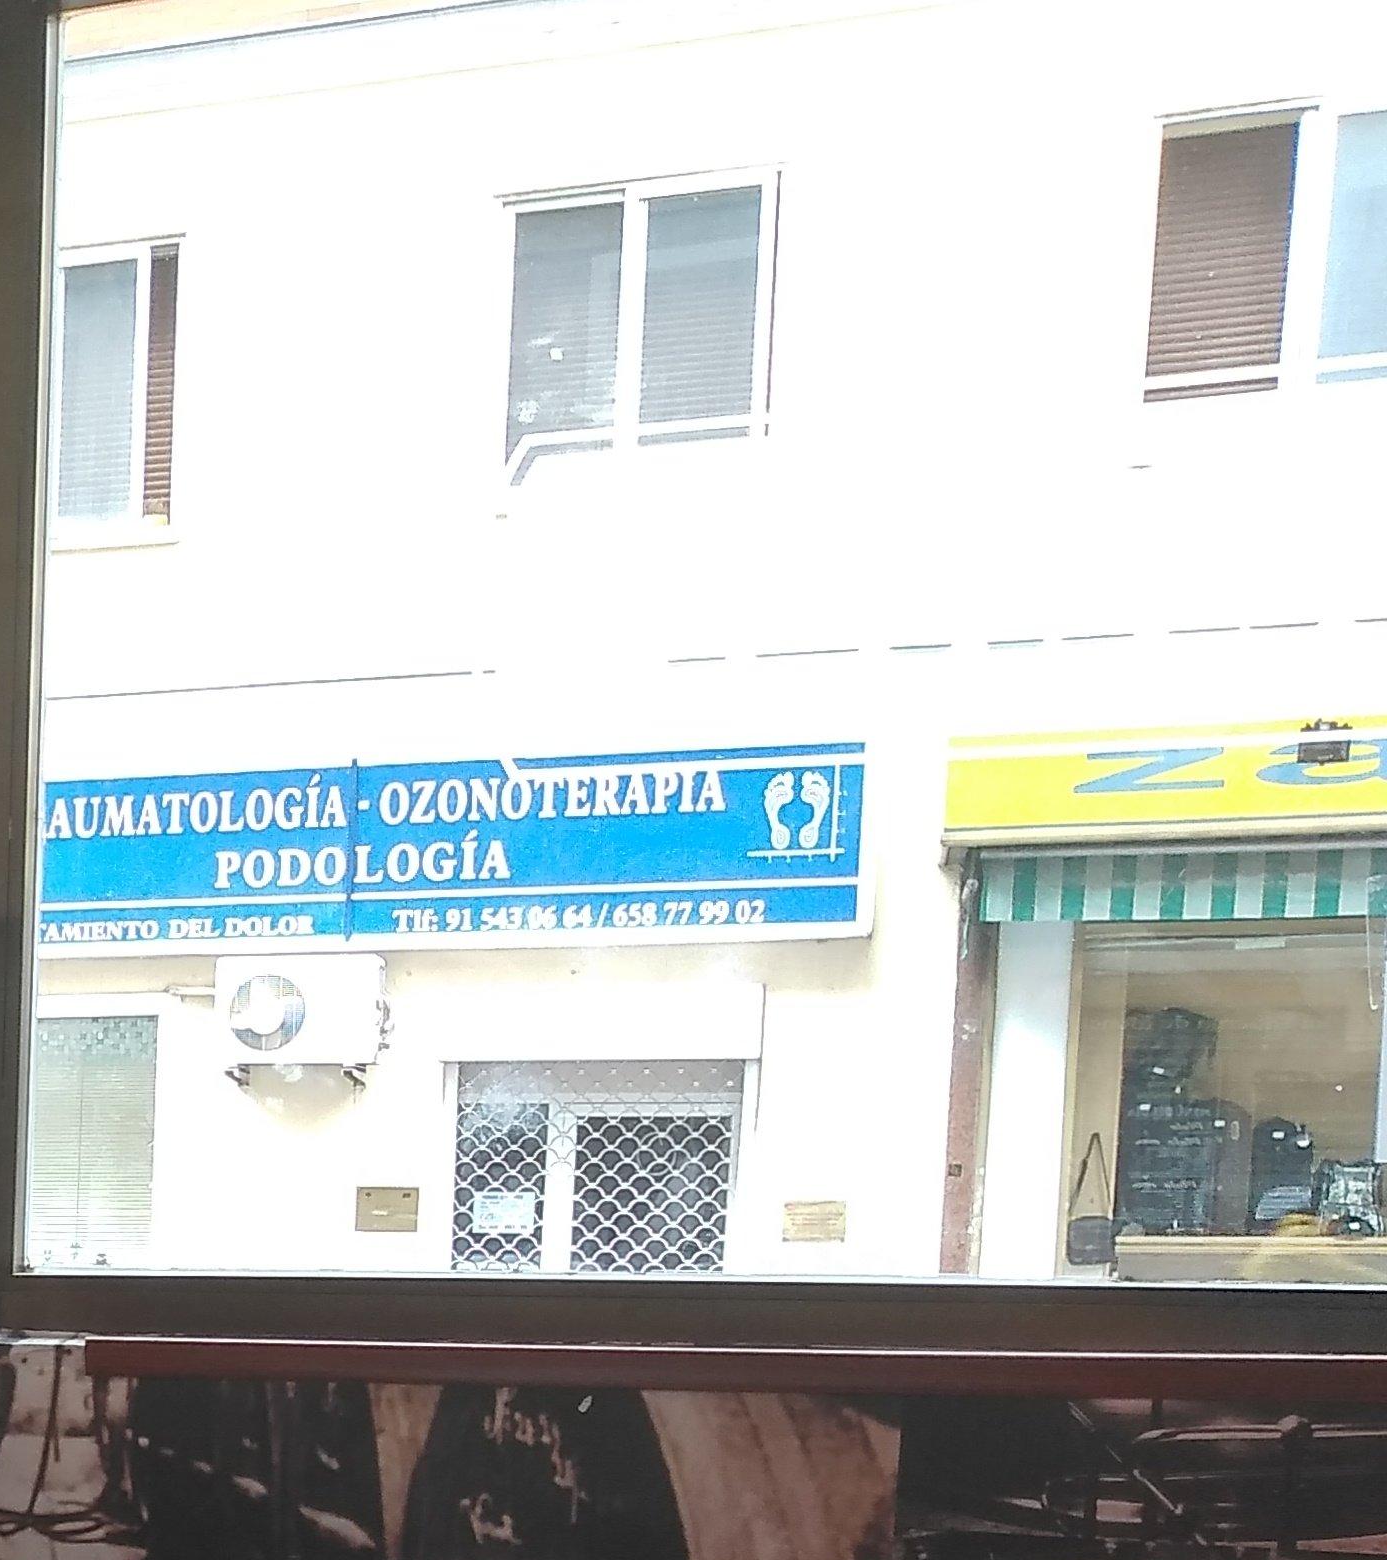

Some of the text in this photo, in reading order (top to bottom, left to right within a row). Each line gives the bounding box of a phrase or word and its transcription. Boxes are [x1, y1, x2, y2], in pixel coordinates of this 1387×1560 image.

[379, 770, 727, 825] OZONOTERAPIA
[214, 839, 512, 889] PODOLOGÍA
[168, 917, 220, 939] DEL
[445, 908, 473, 931] 91
[480, 906, 525, 930] 543
[528, 905, 558, 929] 06
[562, 904, 594, 929] 64
[613, 902, 658, 927] 658
[663, 901, 693, 925] 77
[698, 900, 728, 925] 99
[734, 900, 767, 924] 02
